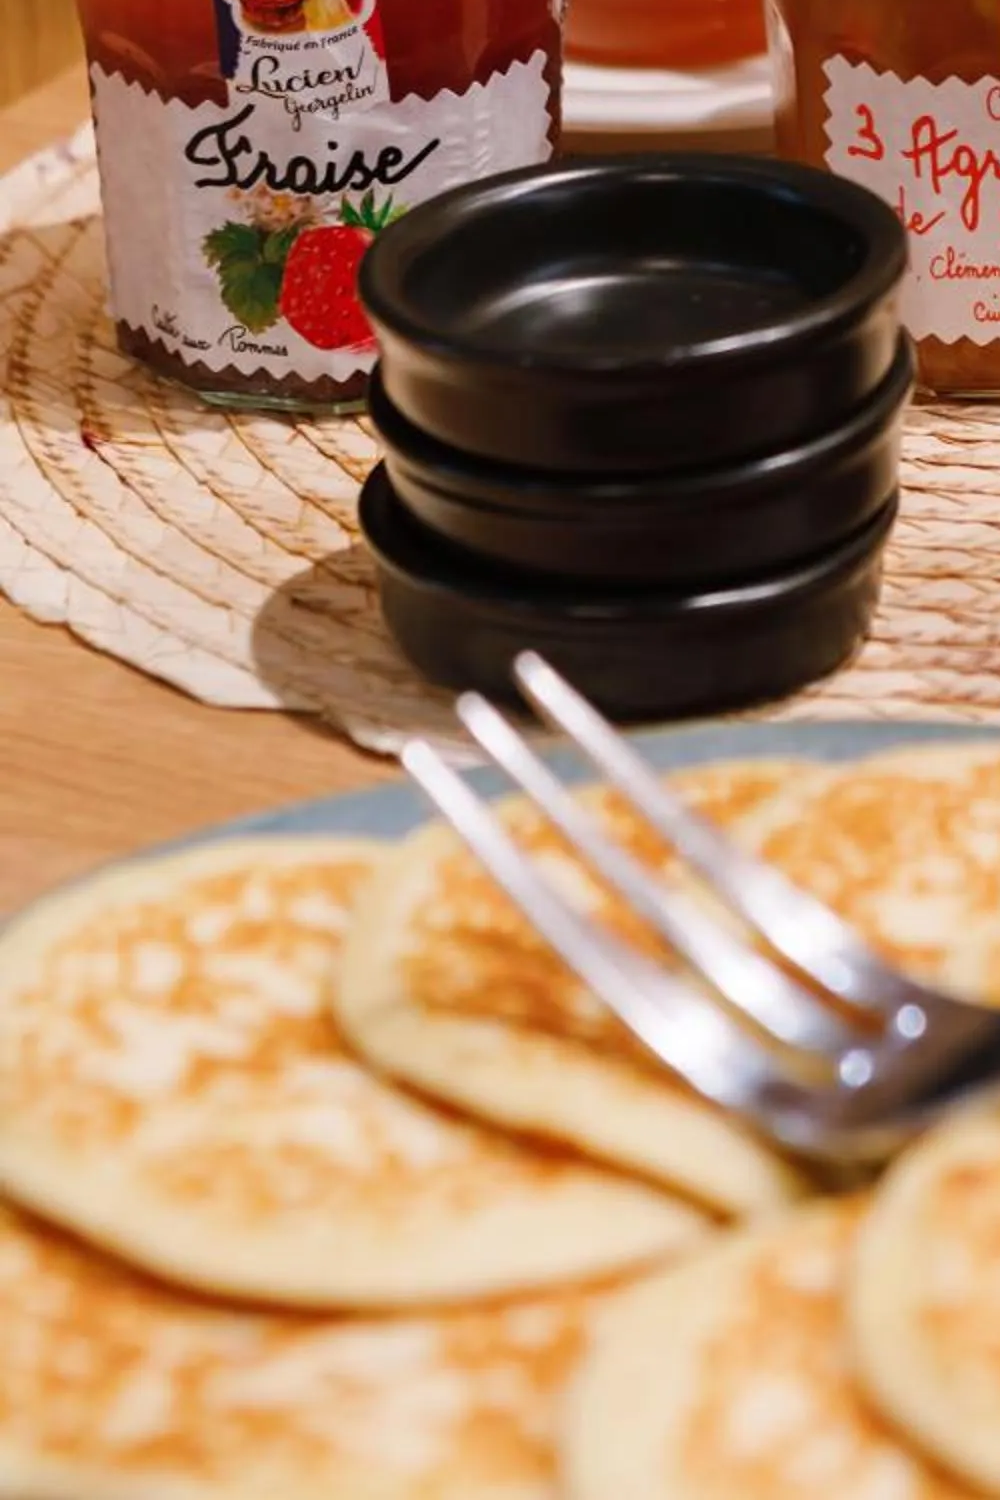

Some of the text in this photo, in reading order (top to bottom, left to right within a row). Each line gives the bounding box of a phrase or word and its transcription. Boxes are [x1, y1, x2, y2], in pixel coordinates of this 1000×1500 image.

[236, 45, 365, 99] Lucien
[304, 40, 319, 50] en
[284, 63, 378, 132] Georgelin
[184, 103, 441, 193] Fraise
[847, 104, 885, 161] 3
